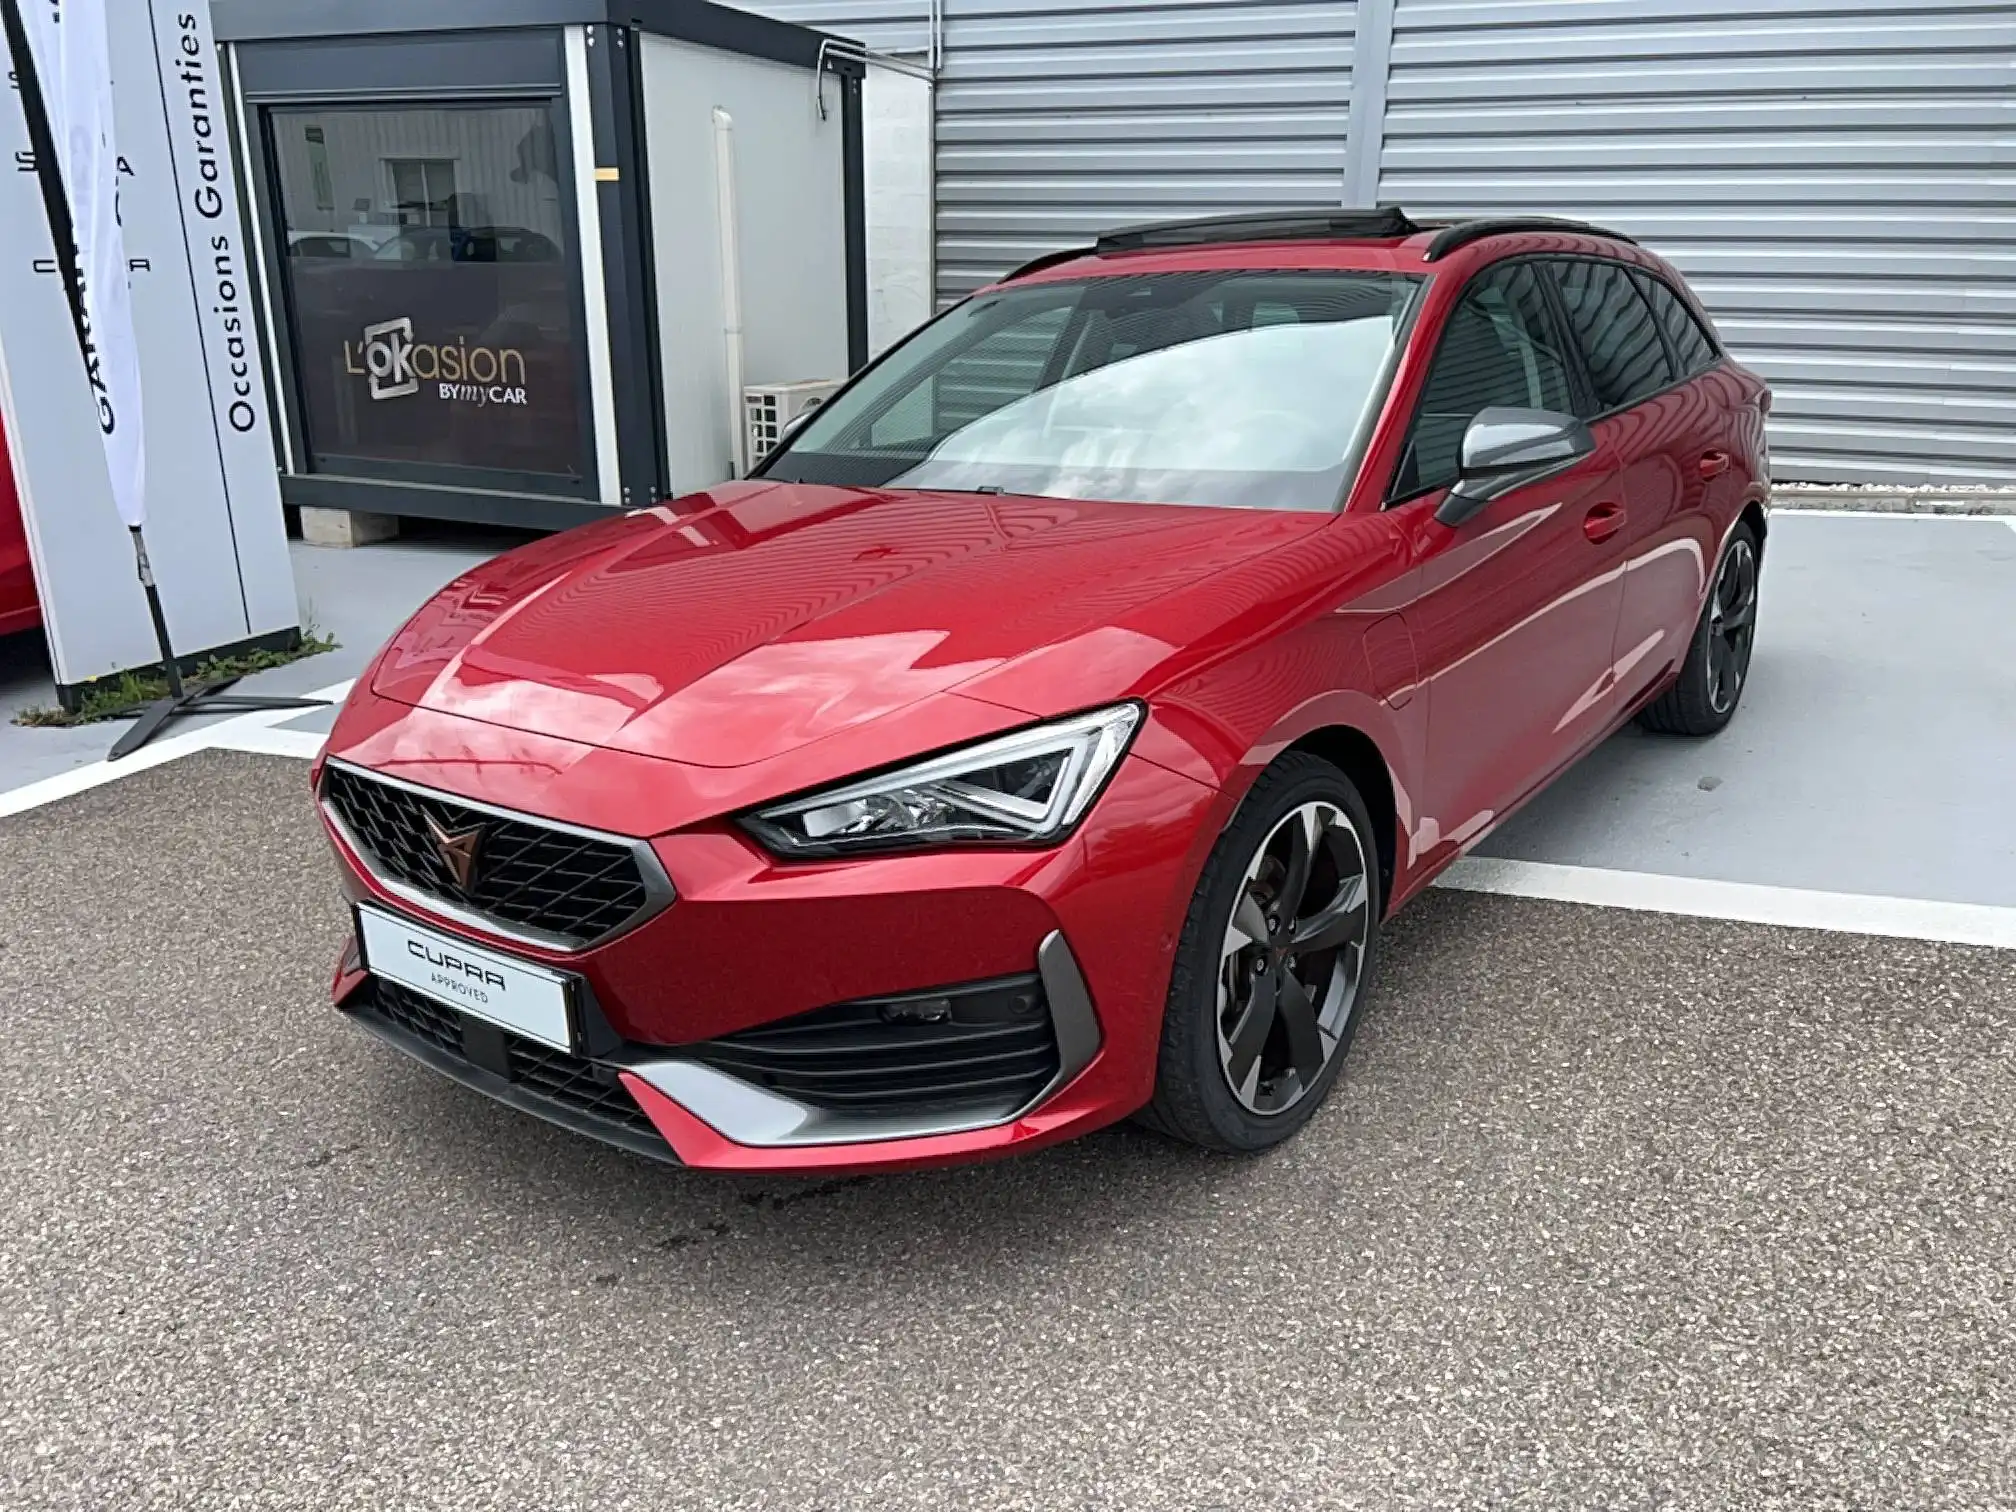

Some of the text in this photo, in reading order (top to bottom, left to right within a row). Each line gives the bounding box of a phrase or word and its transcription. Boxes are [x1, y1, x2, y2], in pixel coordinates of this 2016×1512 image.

[175, 12, 255, 432] Occasions Garanties
[407, 940, 506, 991] CUPRA
[431, 972, 488, 1003] APPROVED
